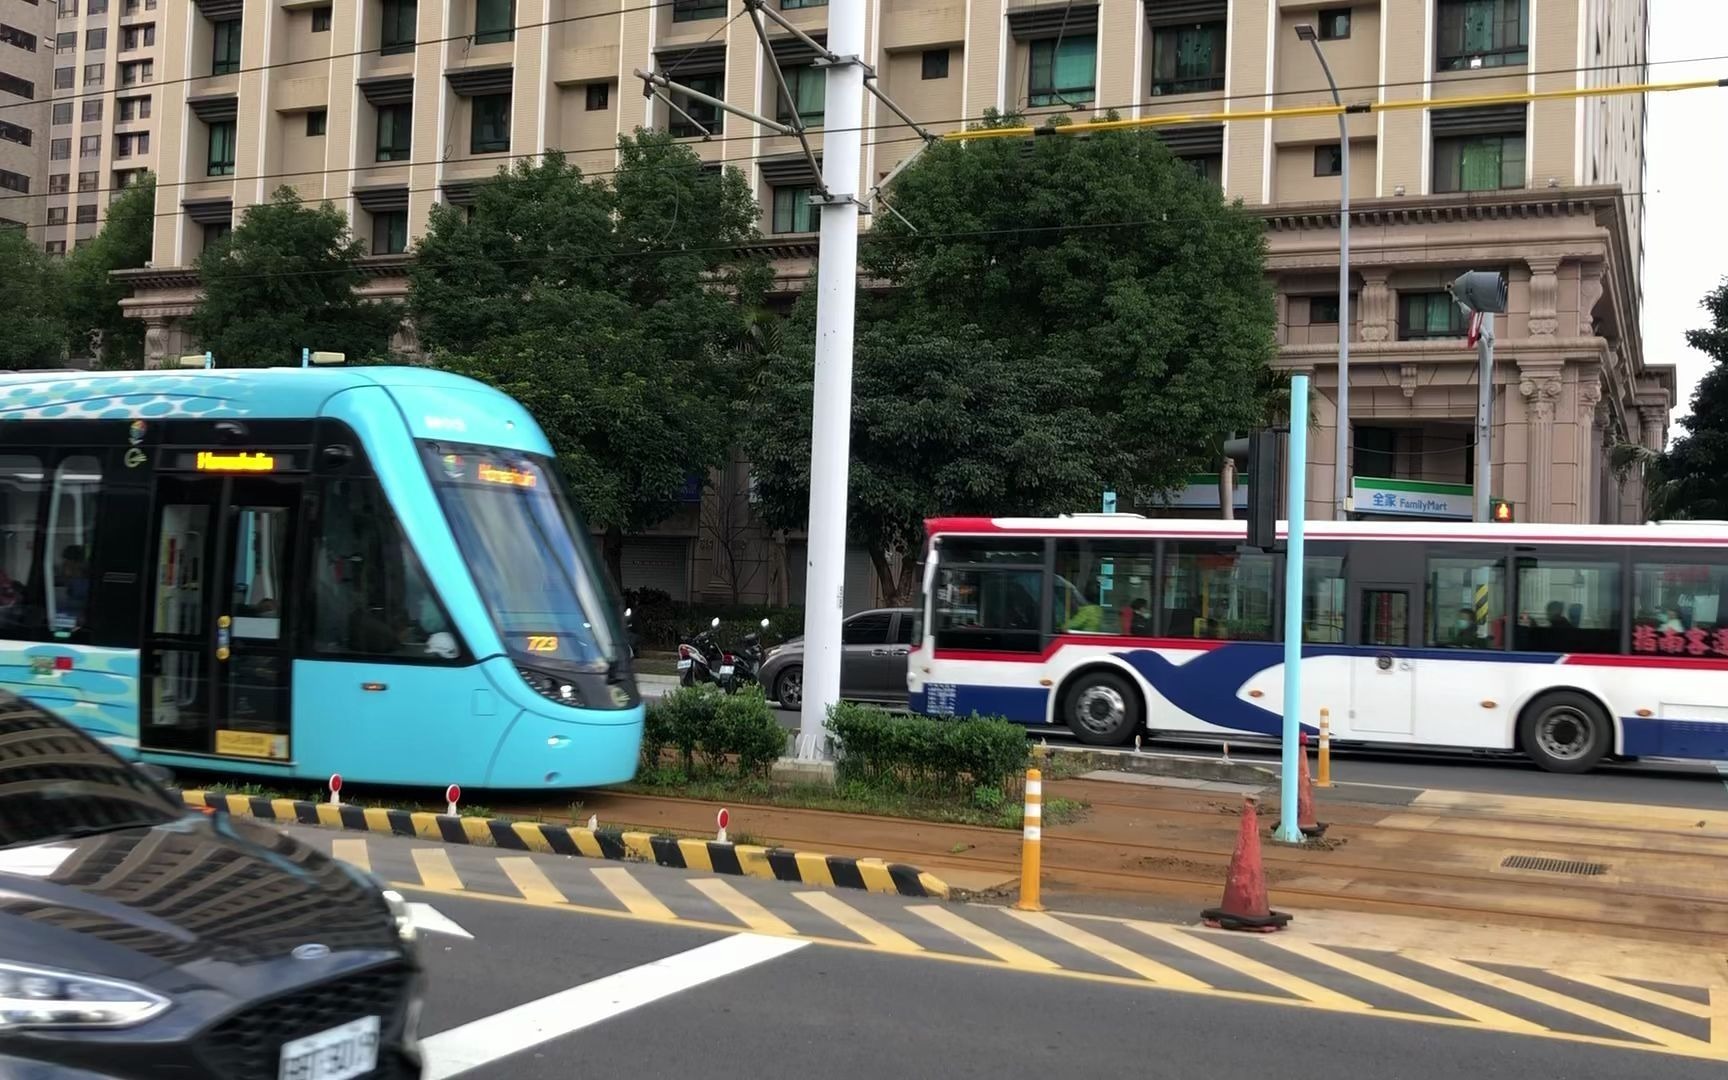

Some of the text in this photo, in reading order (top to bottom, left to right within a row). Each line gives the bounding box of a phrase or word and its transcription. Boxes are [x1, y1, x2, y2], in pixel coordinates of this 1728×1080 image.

[1372, 492, 1448, 512] 全家 FamilyMart
[526, 635, 559, 651] 723
